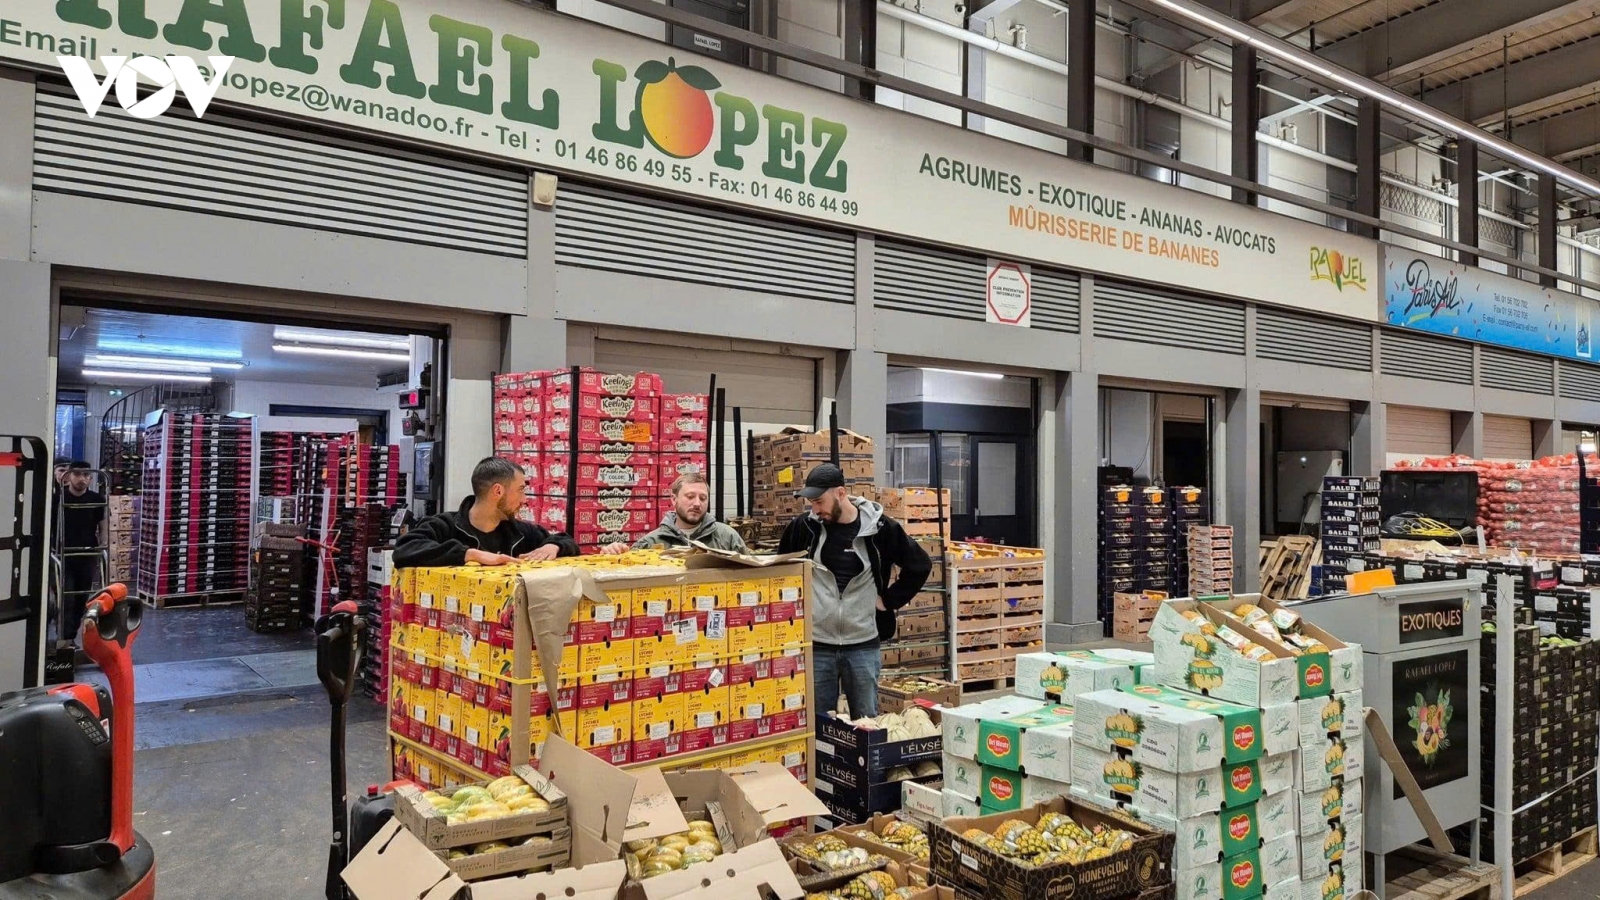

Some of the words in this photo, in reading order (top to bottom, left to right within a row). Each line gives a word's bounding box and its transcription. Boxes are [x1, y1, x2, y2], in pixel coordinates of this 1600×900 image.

[0, 20, 97, 60] Email
[132, 52, 473, 138] elopez@wanadoo.fr
[495, 125, 527, 149] Tel
[555, 139, 577, 160] 01
[585, 146, 609, 166] 46
[615, 153, 638, 173] 86
[643, 158, 665, 178] 49
[671, 164, 692, 184] 55
[709, 172, 745, 195] Fax:
[750, 181, 768, 199] 01
[774, 184, 793, 204] 46
[797, 190, 815, 208] 86
[820, 195, 838, 212] 44
[842, 200, 859, 217] 99
[919, 152, 1022, 197] AGRUMES
[1039, 182, 1127, 222] EXOTIQUE
[1140, 207, 1203, 239] ANANAS
[1214, 224, 1276, 255] AVOCATS
[1009, 205, 1118, 248] MÛRISSERIE
[1122, 233, 1144, 252] DE
[1148, 237, 1220, 268] BANANES
[602, 375, 633, 390] Keelings
[602, 398, 633, 412] Keelings
[601, 420, 626, 433] Keelin
[628, 473, 635, 482] M
[1365, 481, 1381, 490] SALUD
[1363, 496, 1379, 505] SALUD
[598, 511, 629, 525] Keelings
[1361, 511, 1380, 520] SALUD
[1363, 526, 1380, 535] SALUD
[1364, 541, 1380, 550] SALUD
[1401, 608, 1462, 632] EXOTIQUES
[1405, 665, 1434, 679] RAFAEL
[1434, 659, 1457, 675] LOPEZ
[822, 723, 857, 744] L'ÉLYSÉE
[1234, 732, 1242, 740] Del
[1242, 730, 1254, 739] Monte
[901, 738, 942, 755] L'ÉLYSÉ
[988, 738, 996, 746] Del
[996, 739, 1009, 749] Monte
[820, 762, 857, 785] L'ÉLYSÉE
[1232, 774, 1240, 783] Del
[1239, 772, 1252, 781] Monte
[998, 783, 1011, 793] Monte
[824, 799, 858, 821] 'ÉLYSÉE
[1230, 823, 1238, 831] Del
[1237, 820, 1249, 829] Monte
[961, 843, 993, 867] NEYGLOW
[1078, 858, 1129, 885] HONEYGLOW
[1232, 871, 1240, 880] Del
[1239, 867, 1252, 877] Monte
[1048, 885, 1057, 896] Del
[1056, 881, 1074, 894] Monte
[1092, 876, 1120, 888] PINEAPPLE
[1096, 884, 1116, 895] ANANAS
